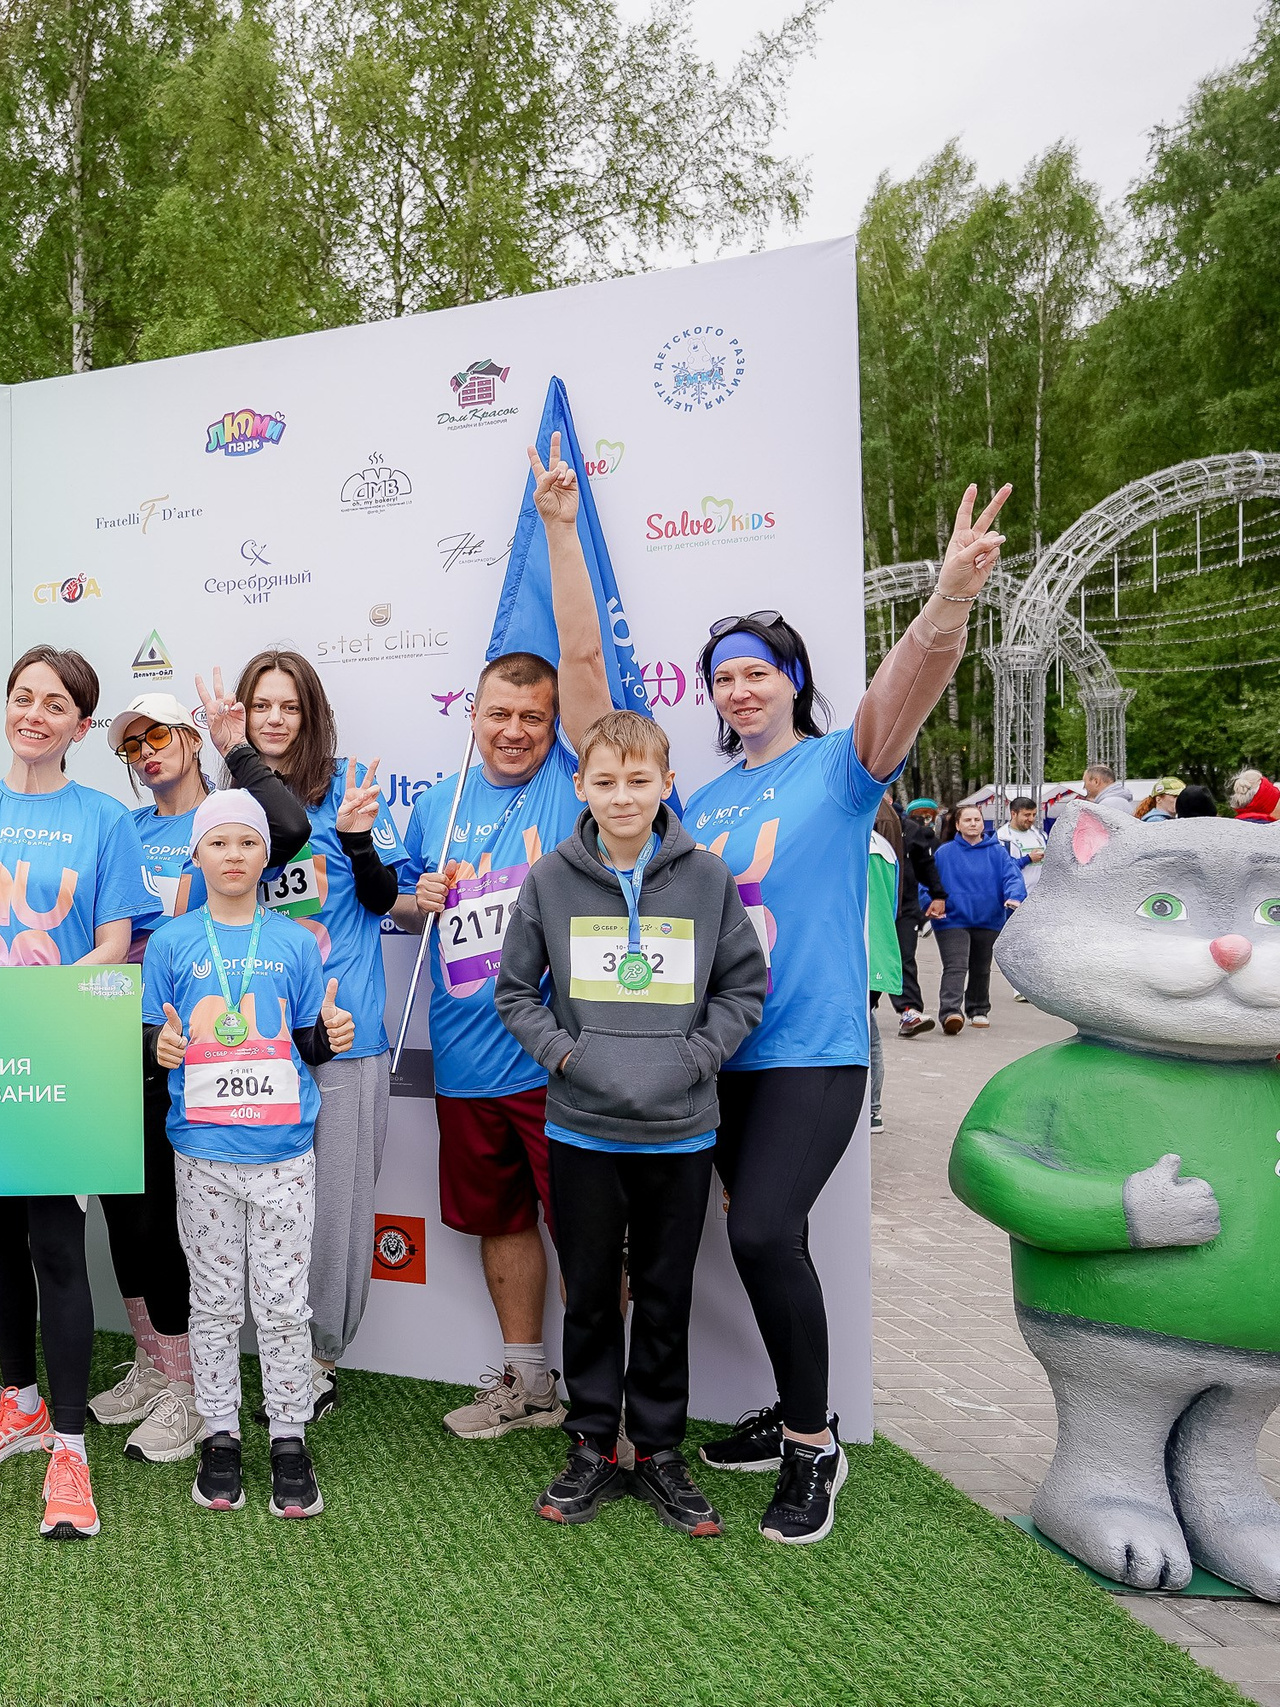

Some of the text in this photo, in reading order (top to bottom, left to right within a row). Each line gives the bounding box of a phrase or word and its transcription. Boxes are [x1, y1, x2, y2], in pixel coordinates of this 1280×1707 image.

[654, 326, 724, 371] ДЕТСКОГО
[705, 338, 745, 410] РАЗВИТИЯ
[654, 381, 693, 412] ЦЕНТР
[95, 513, 140, 530] Fratelli
[646, 510, 716, 540] Salve
[646, 533, 776, 553] Центр детской стоматологии
[204, 569, 312, 595] Серебряный
[384, 628, 448, 651] clinic
[0, 827, 73, 844] ЮГОРИЯ
[602, 952, 664, 974] 32
[215, 1075, 274, 1098] 2804
